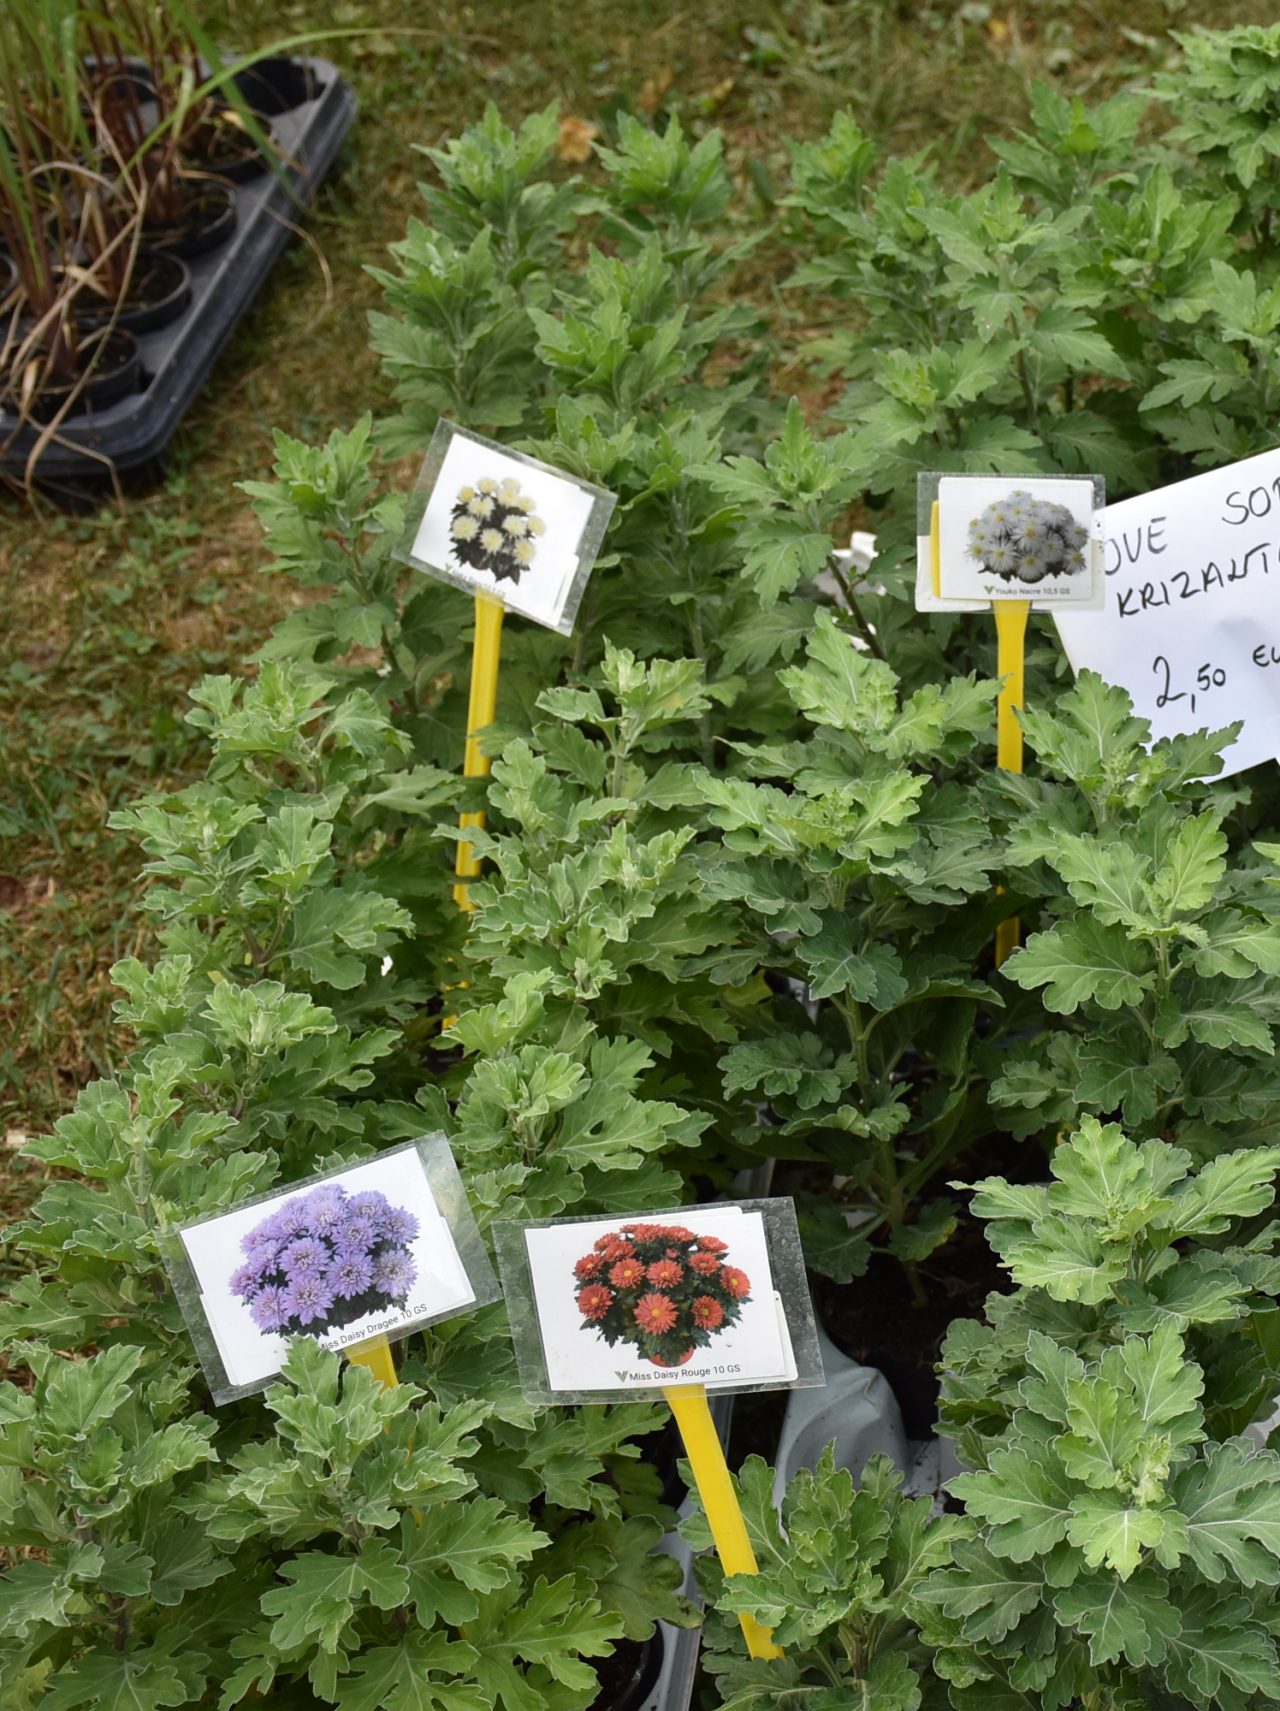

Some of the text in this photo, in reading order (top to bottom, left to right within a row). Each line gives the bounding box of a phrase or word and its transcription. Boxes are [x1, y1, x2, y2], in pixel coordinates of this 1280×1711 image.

[1104, 516, 1168, 575] OVE
[1152, 655, 1226, 713] 2,50
[340, 1330, 366, 1345] Daisy
[366, 1316, 399, 1334] Dragee
[401, 1309, 412, 1320] 10
[414, 1304, 428, 1316] GS
[629, 1364, 741, 1381] Miss Daisy Rouge 10 GS
